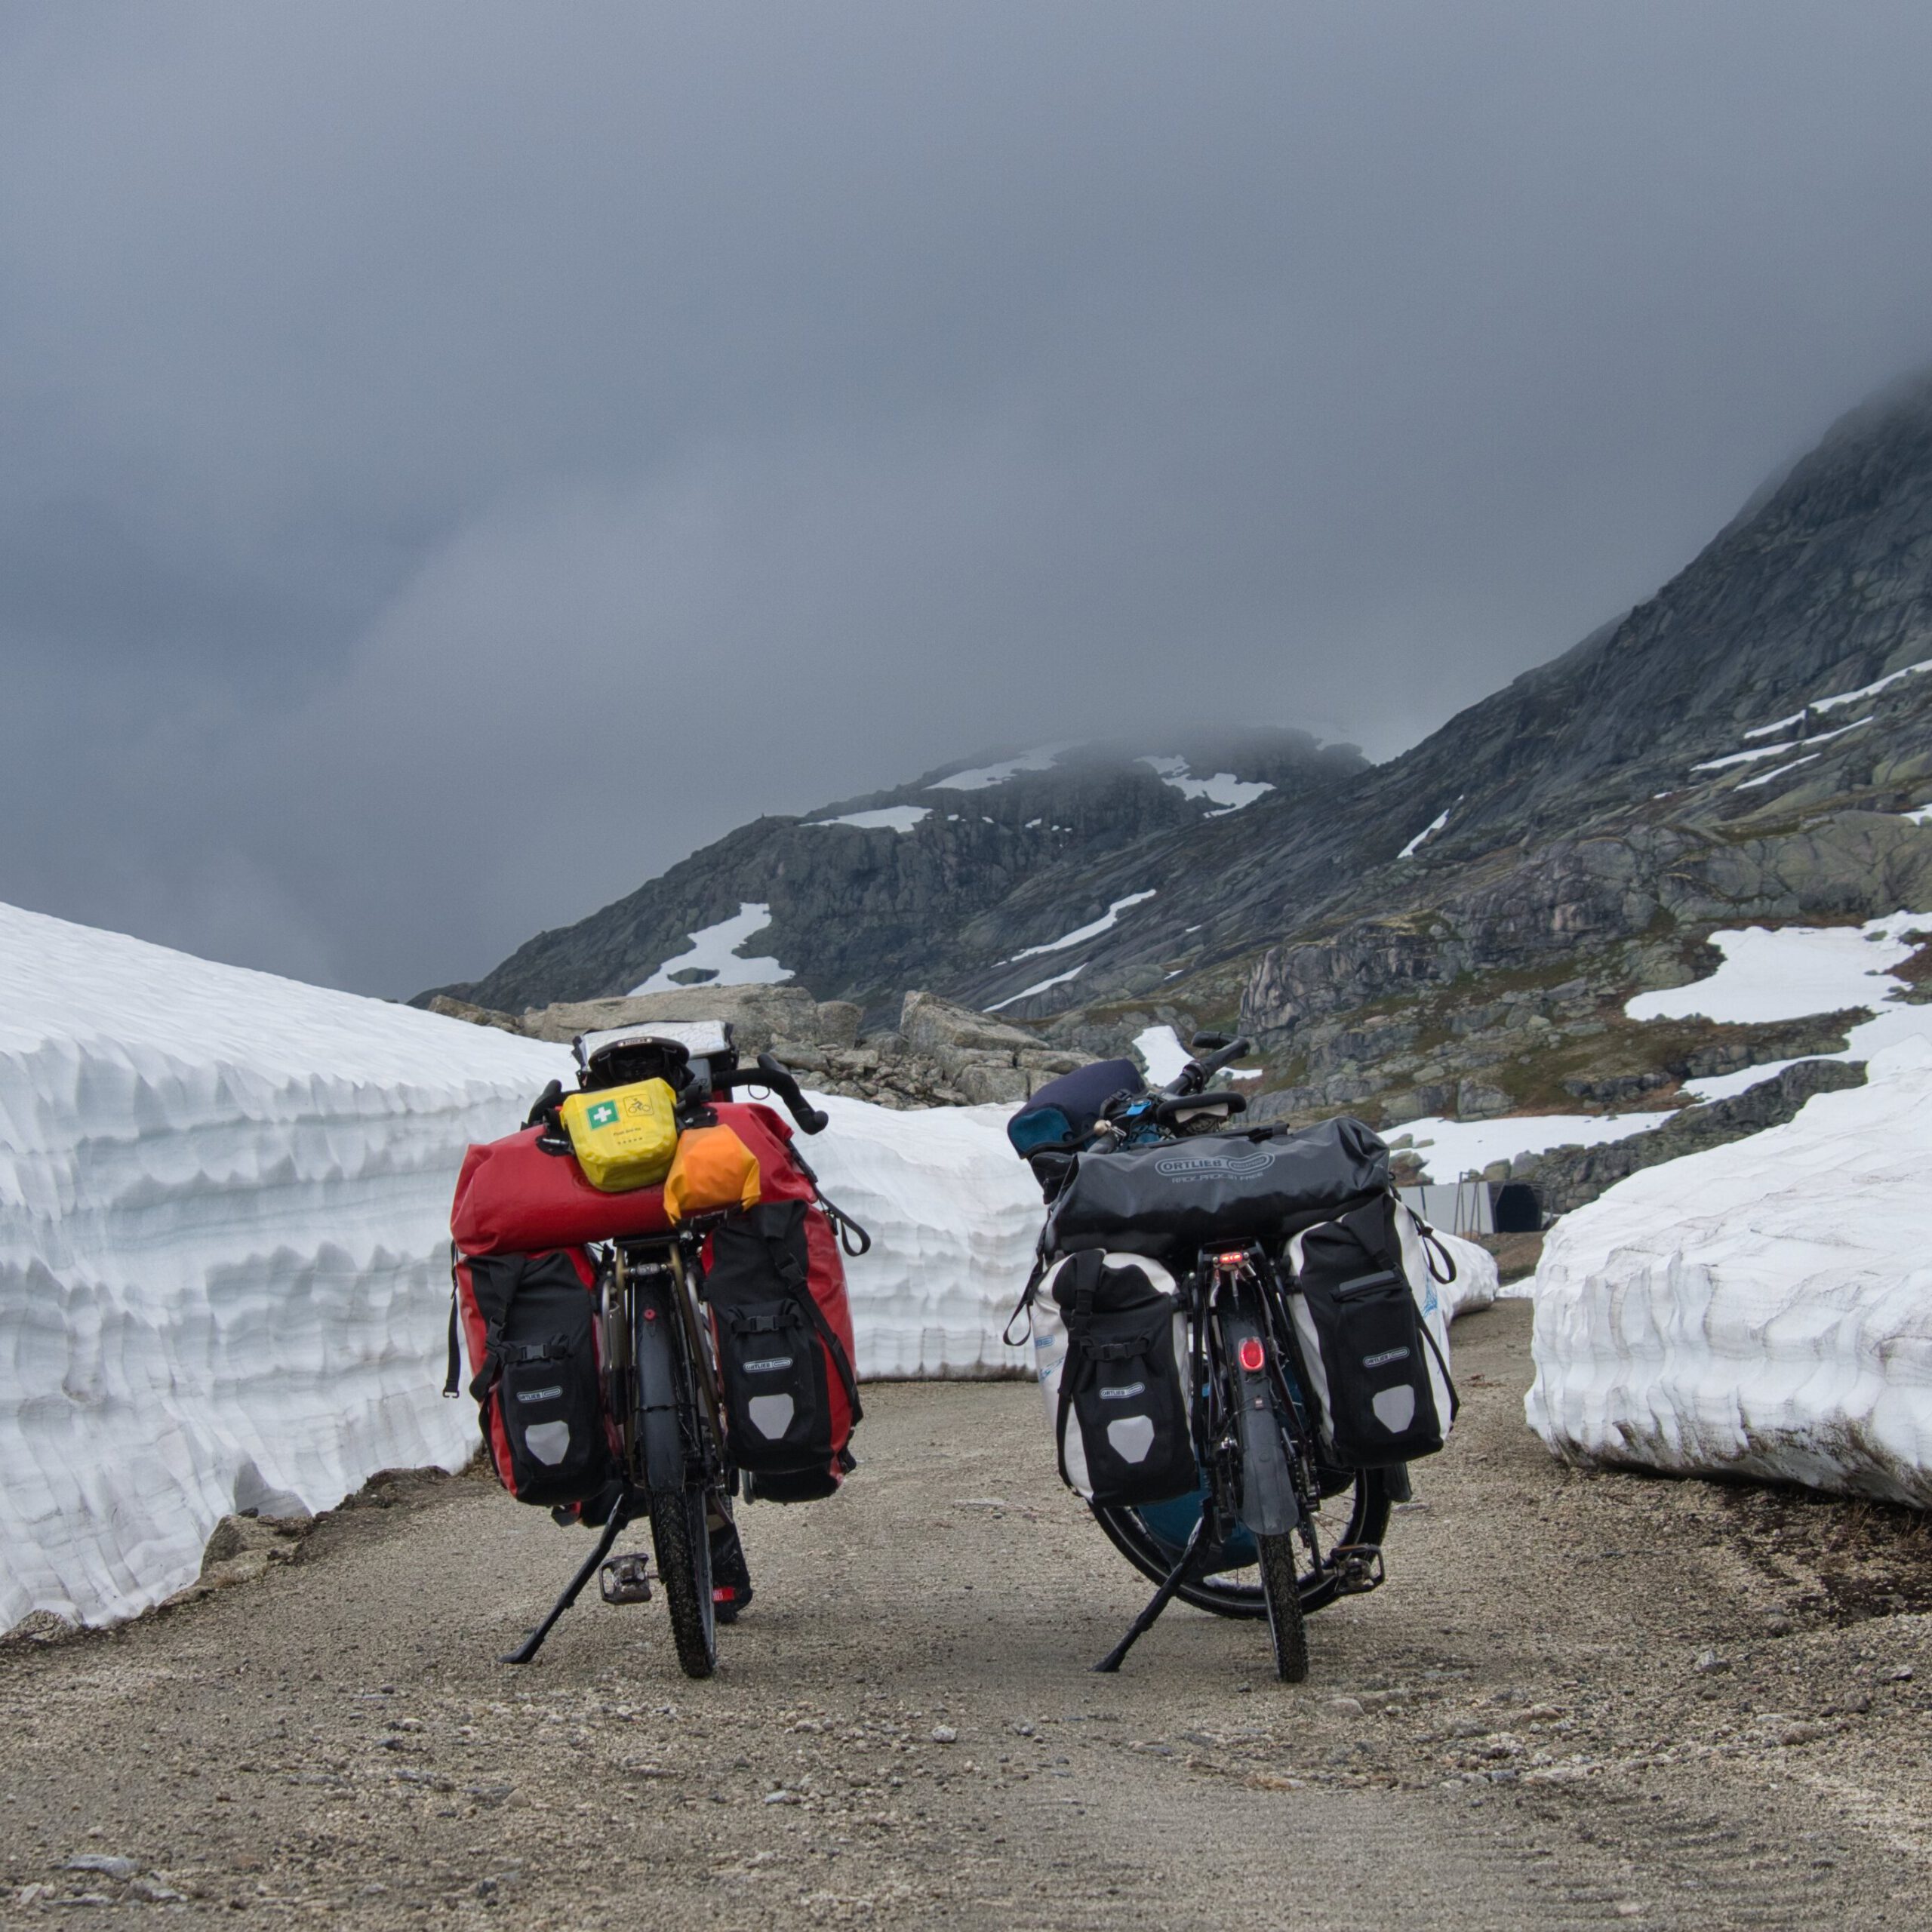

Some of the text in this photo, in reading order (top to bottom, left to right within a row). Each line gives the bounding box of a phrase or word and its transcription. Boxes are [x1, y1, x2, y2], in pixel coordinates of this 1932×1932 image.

[1162, 1159, 1222, 1171] ORTLIEB
[1365, 1354, 1389, 1364] ORTLIEB
[746, 1361, 771, 1370] ORTLIEB
